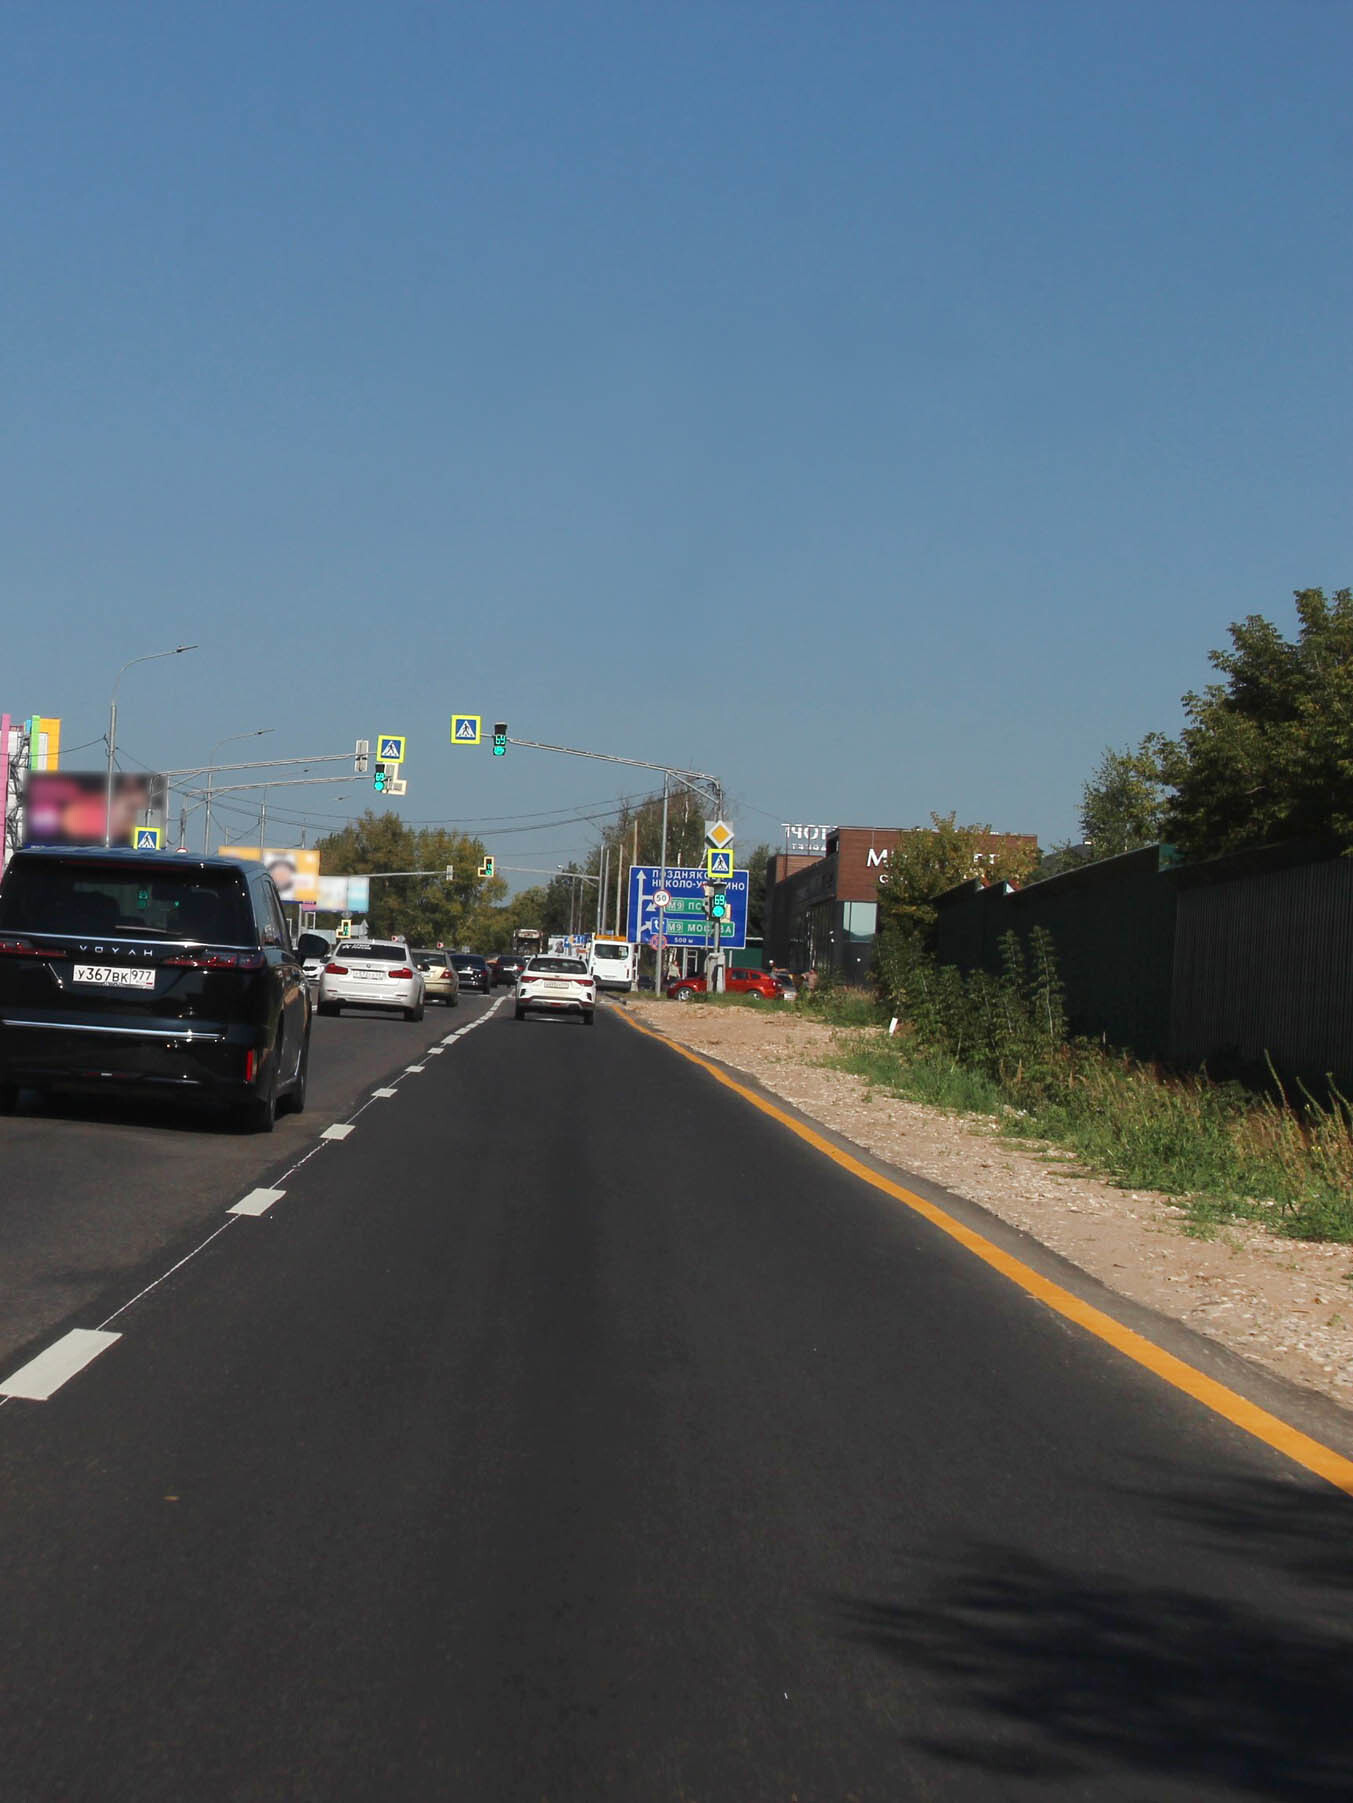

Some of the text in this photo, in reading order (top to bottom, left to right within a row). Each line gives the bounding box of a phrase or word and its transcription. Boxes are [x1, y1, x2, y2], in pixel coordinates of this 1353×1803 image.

[656, 893, 666, 901] 50
[714, 894, 725, 905] 69
[688, 924, 731, 934] МОСВА
[79, 944, 153, 957] VOYAH
